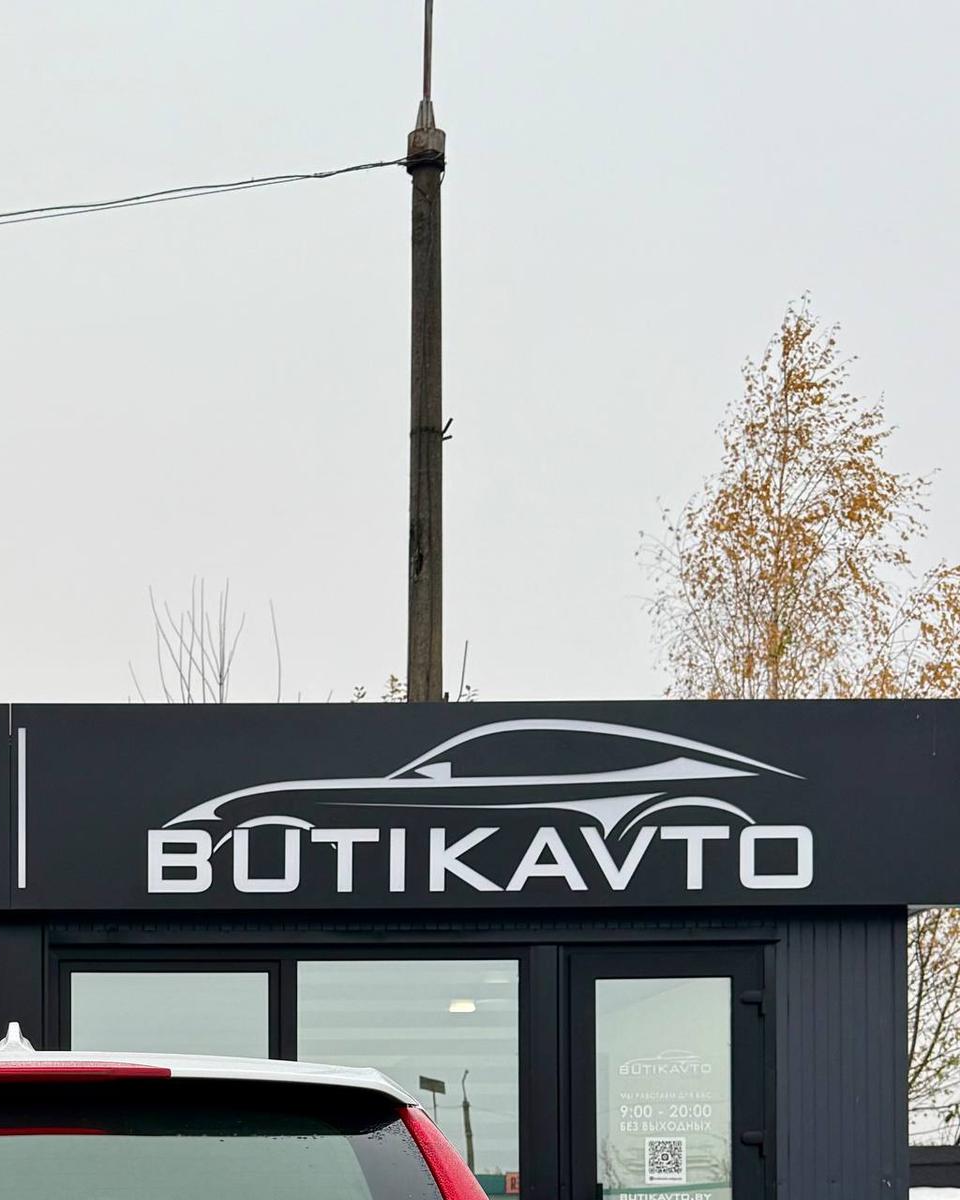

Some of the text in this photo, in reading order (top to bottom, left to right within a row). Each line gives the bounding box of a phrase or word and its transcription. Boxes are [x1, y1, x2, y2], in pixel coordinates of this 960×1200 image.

[147, 825, 814, 894] BUTIKAVTO
[619, 1063, 711, 1075] BUTIKAVTO
[620, 1105, 652, 1118] 9:00
[669, 1104, 712, 1118] 20:00
[620, 1120, 711, 1132] БЕЗ ВЫХОДНЫХ
